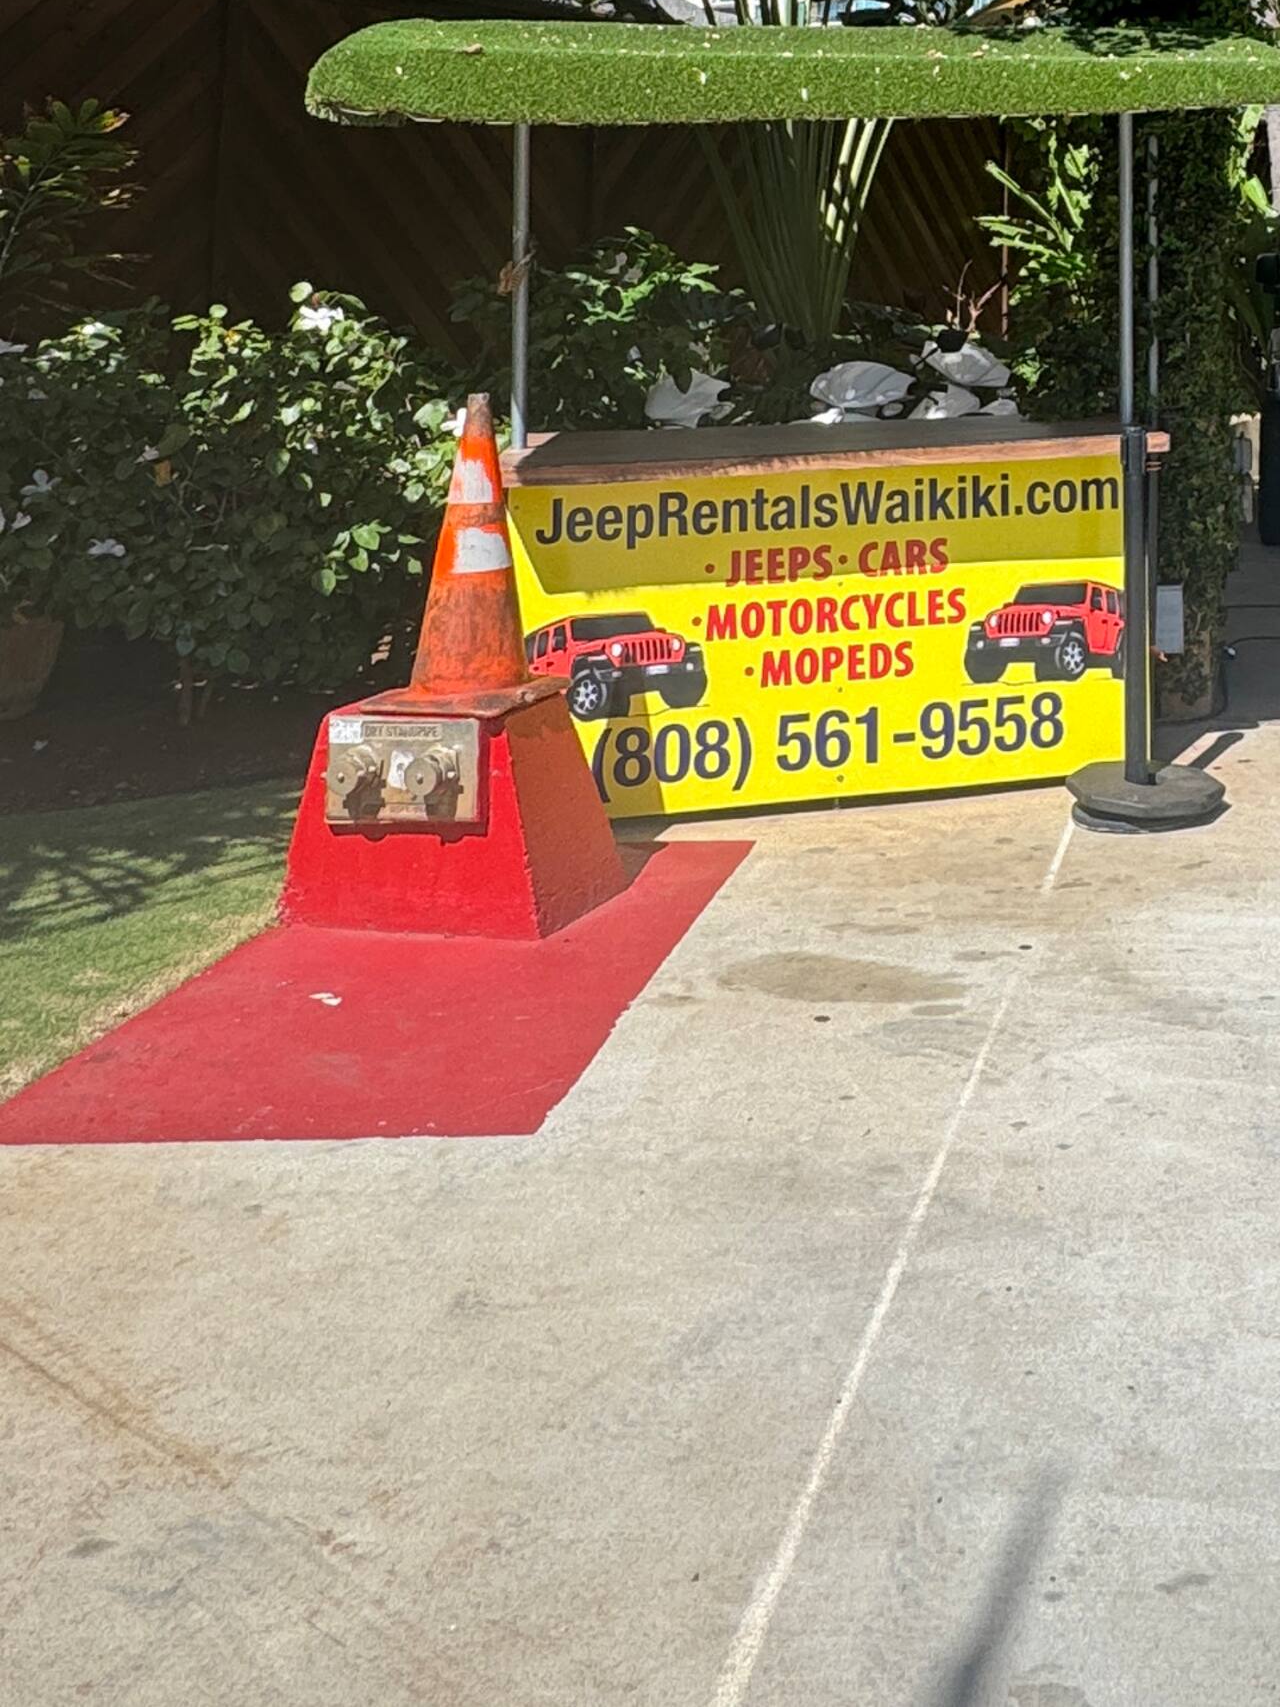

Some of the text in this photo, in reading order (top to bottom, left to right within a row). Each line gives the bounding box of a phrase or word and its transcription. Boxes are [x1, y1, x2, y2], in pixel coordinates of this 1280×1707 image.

[536, 473, 1119, 549] JeepRentalsWaikiki.com
[726, 538, 949, 586] JEEPS CARS
[706, 588, 967, 642] MOTORCYCLES
[761, 641, 914, 687] MOPEDS
[592, 692, 1064, 802] (808) 561-9558
